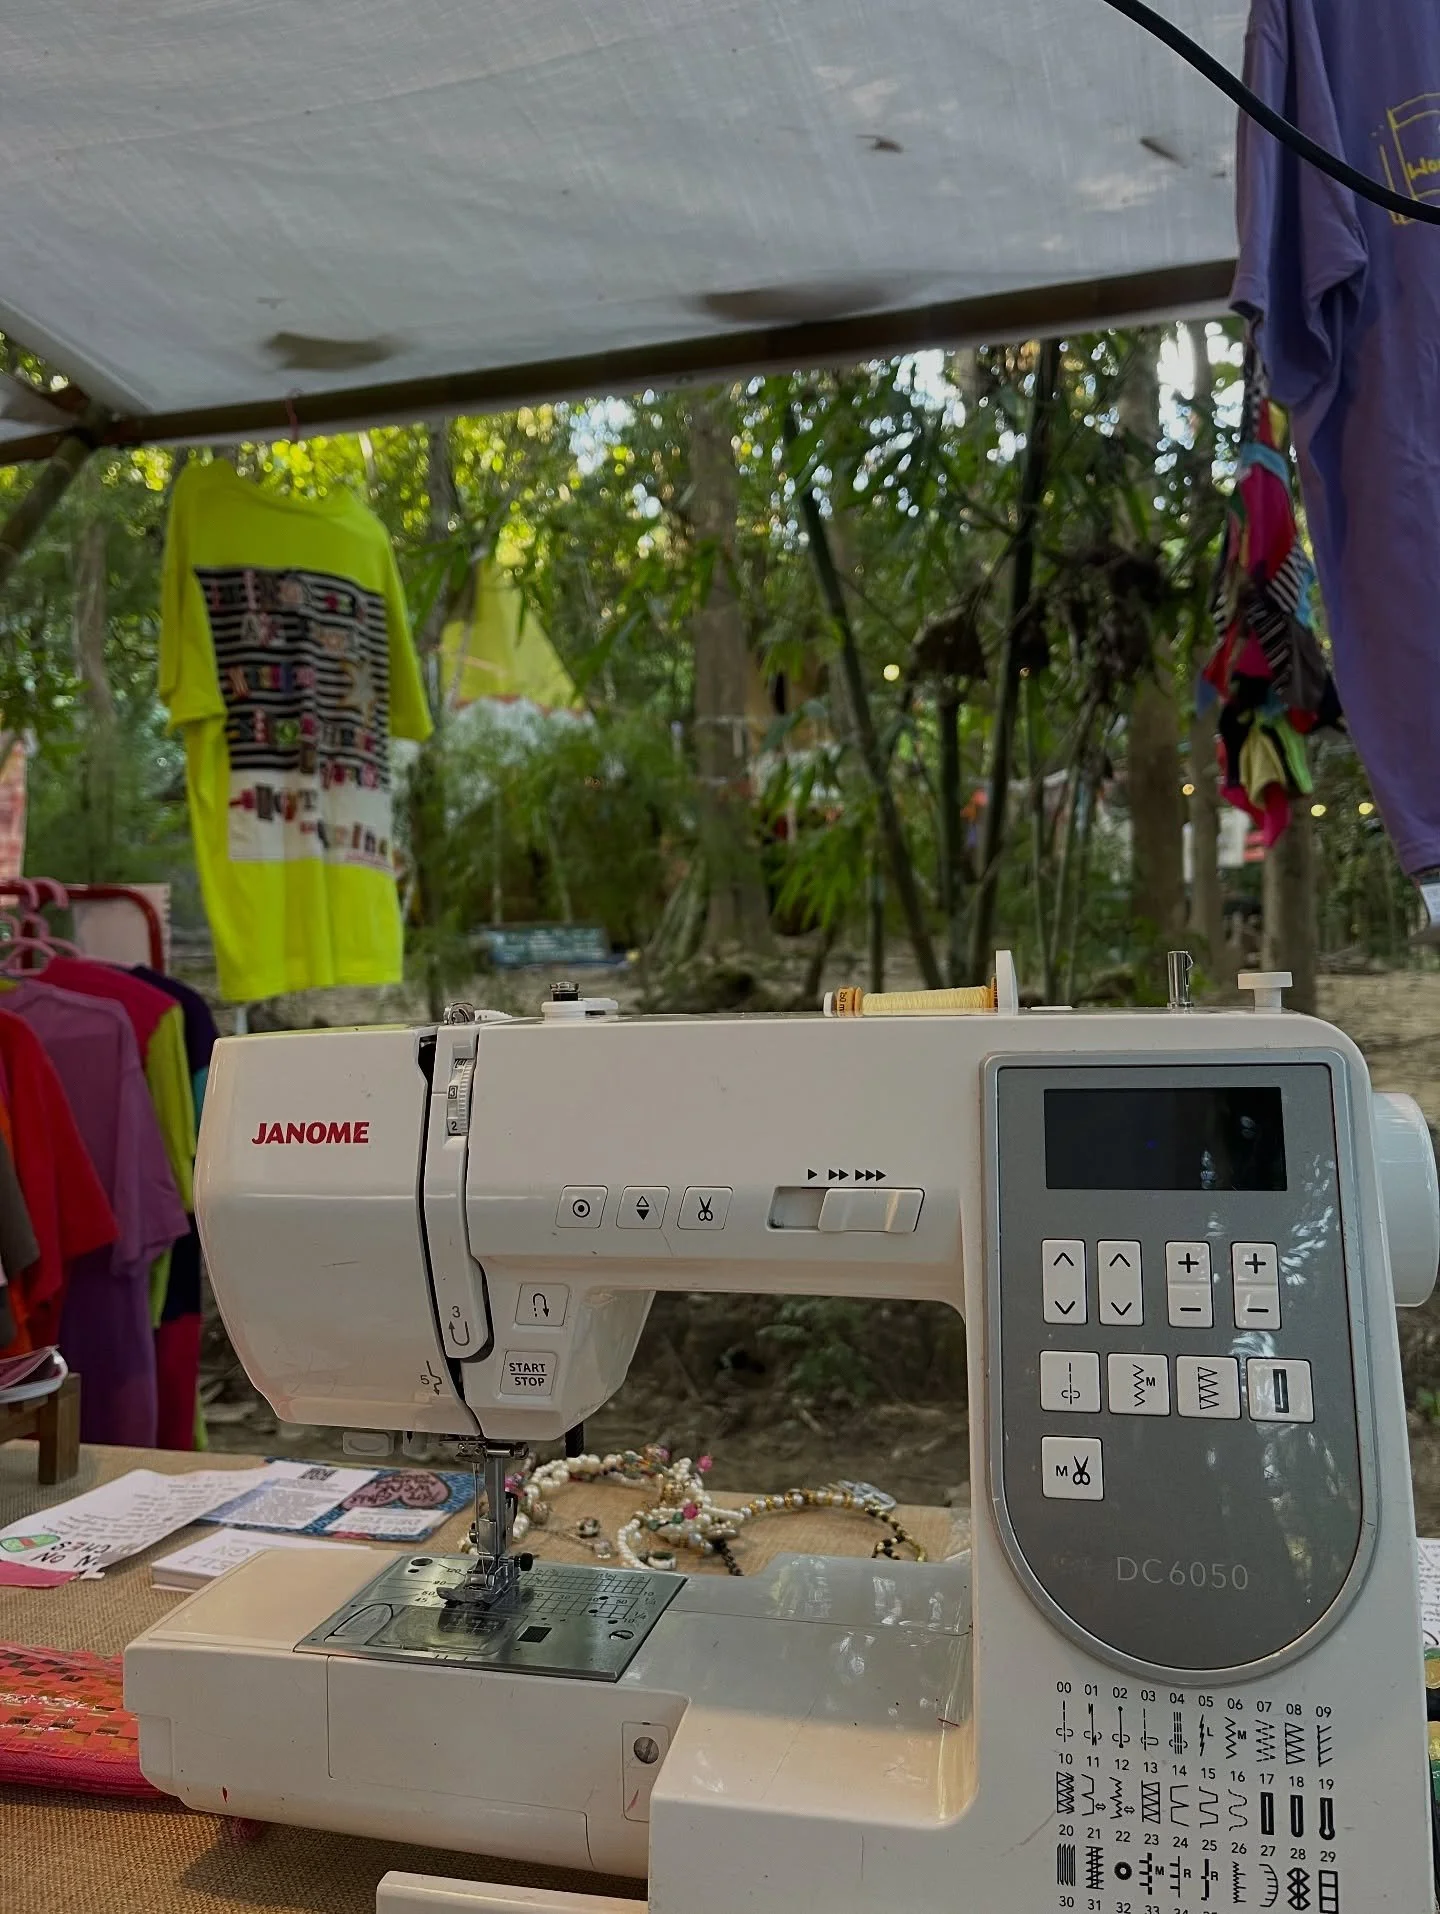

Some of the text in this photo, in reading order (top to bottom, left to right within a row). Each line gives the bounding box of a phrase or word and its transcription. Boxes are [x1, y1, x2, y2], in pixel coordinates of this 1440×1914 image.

[451, 1121, 458, 1131] 2
[252, 1121, 370, 1144] JANOME
[452, 1305, 460, 1318] 3
[509, 1362, 546, 1373] START
[420, 1374, 430, 1385] 5
[514, 1376, 545, 1387] STOP
[1145, 1376, 1156, 1387] M
[1055, 1464, 1068, 1477] M
[1056, 1681, 1332, 1718] 00 01 02 03 04 05 06 07 08 09
[1207, 1727, 1214, 1737] L
[1237, 1730, 1247, 1740] M
[1059, 1753, 1334, 1790] 10 11 12 13 14 15 16 17 18 19
[1059, 1824, 1336, 1862] 20 21 22 23 24 25 26 27 28 29
[1155, 1866, 1164, 1875] M
[1183, 1869, 1191, 1878] R
[1211, 1871, 1219, 1881] R
[1059, 1896, 1074, 1907] 30
[1088, 1899, 1100, 1911] 31
[1116, 1902, 1131, 1914] 32
